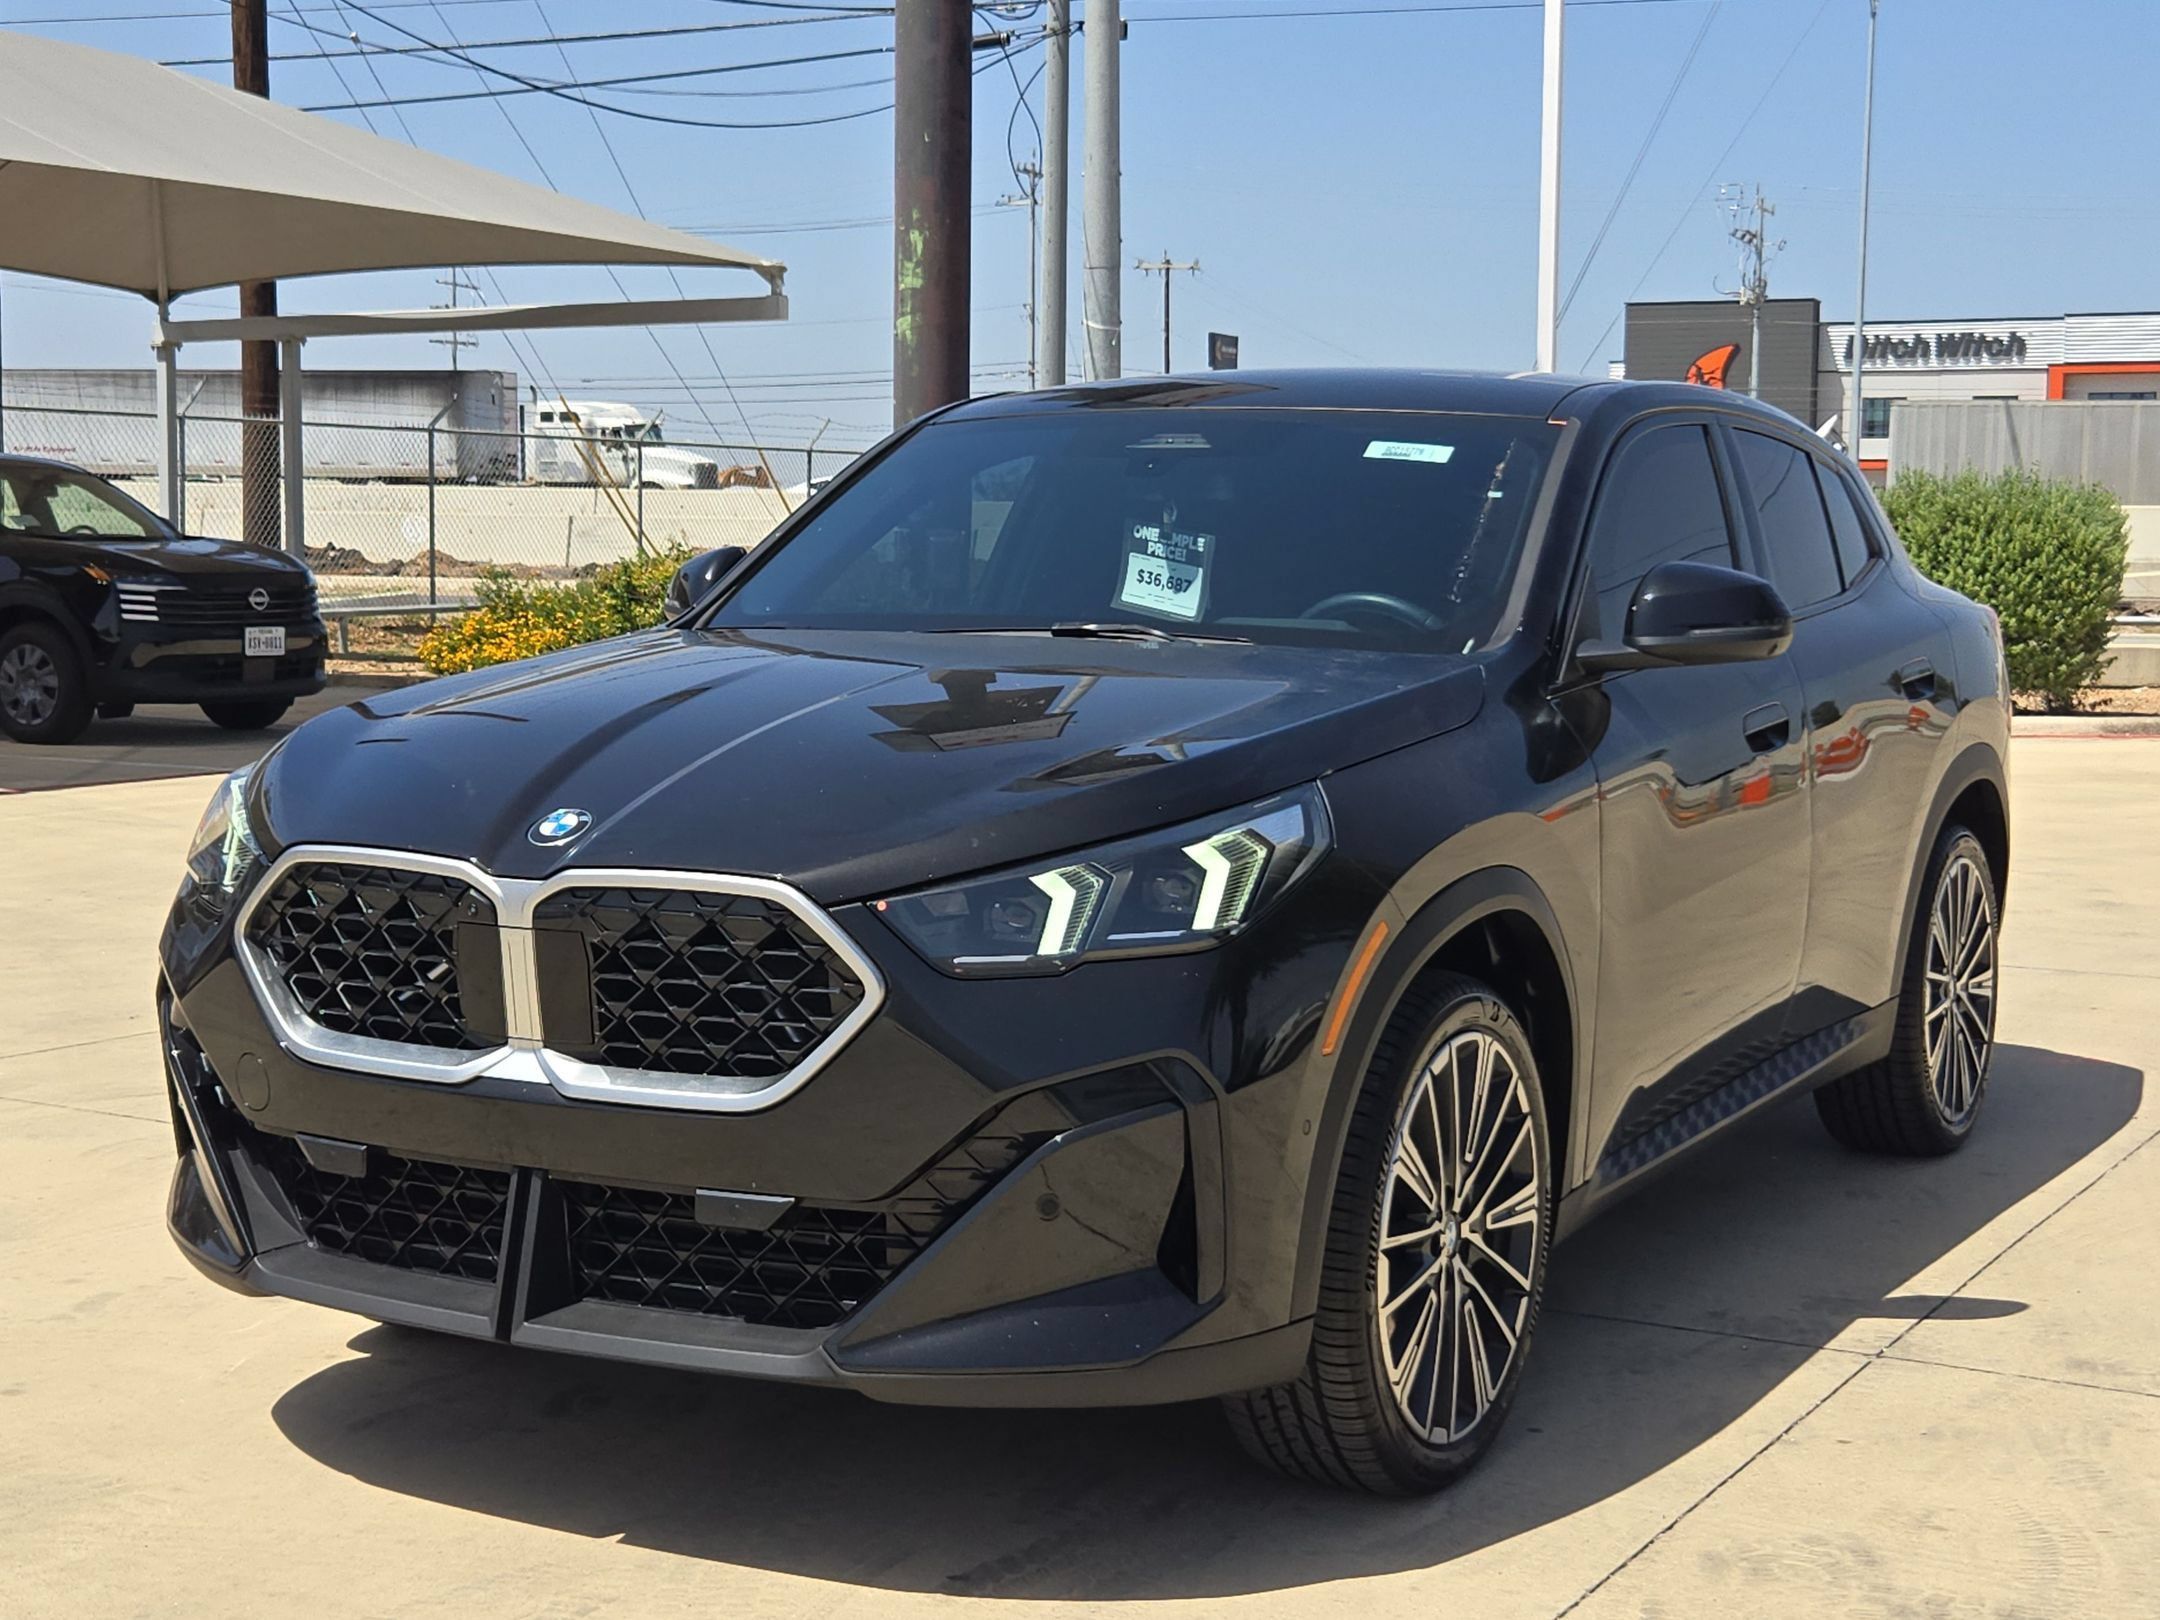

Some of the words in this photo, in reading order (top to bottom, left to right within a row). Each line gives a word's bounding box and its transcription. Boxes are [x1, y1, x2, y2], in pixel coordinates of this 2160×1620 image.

[1935, 331, 2027, 360] Witch
[1133, 524, 1160, 542] ONE
[1160, 532, 1206, 552] MPLE
[1136, 568, 1193, 594] $36,687
